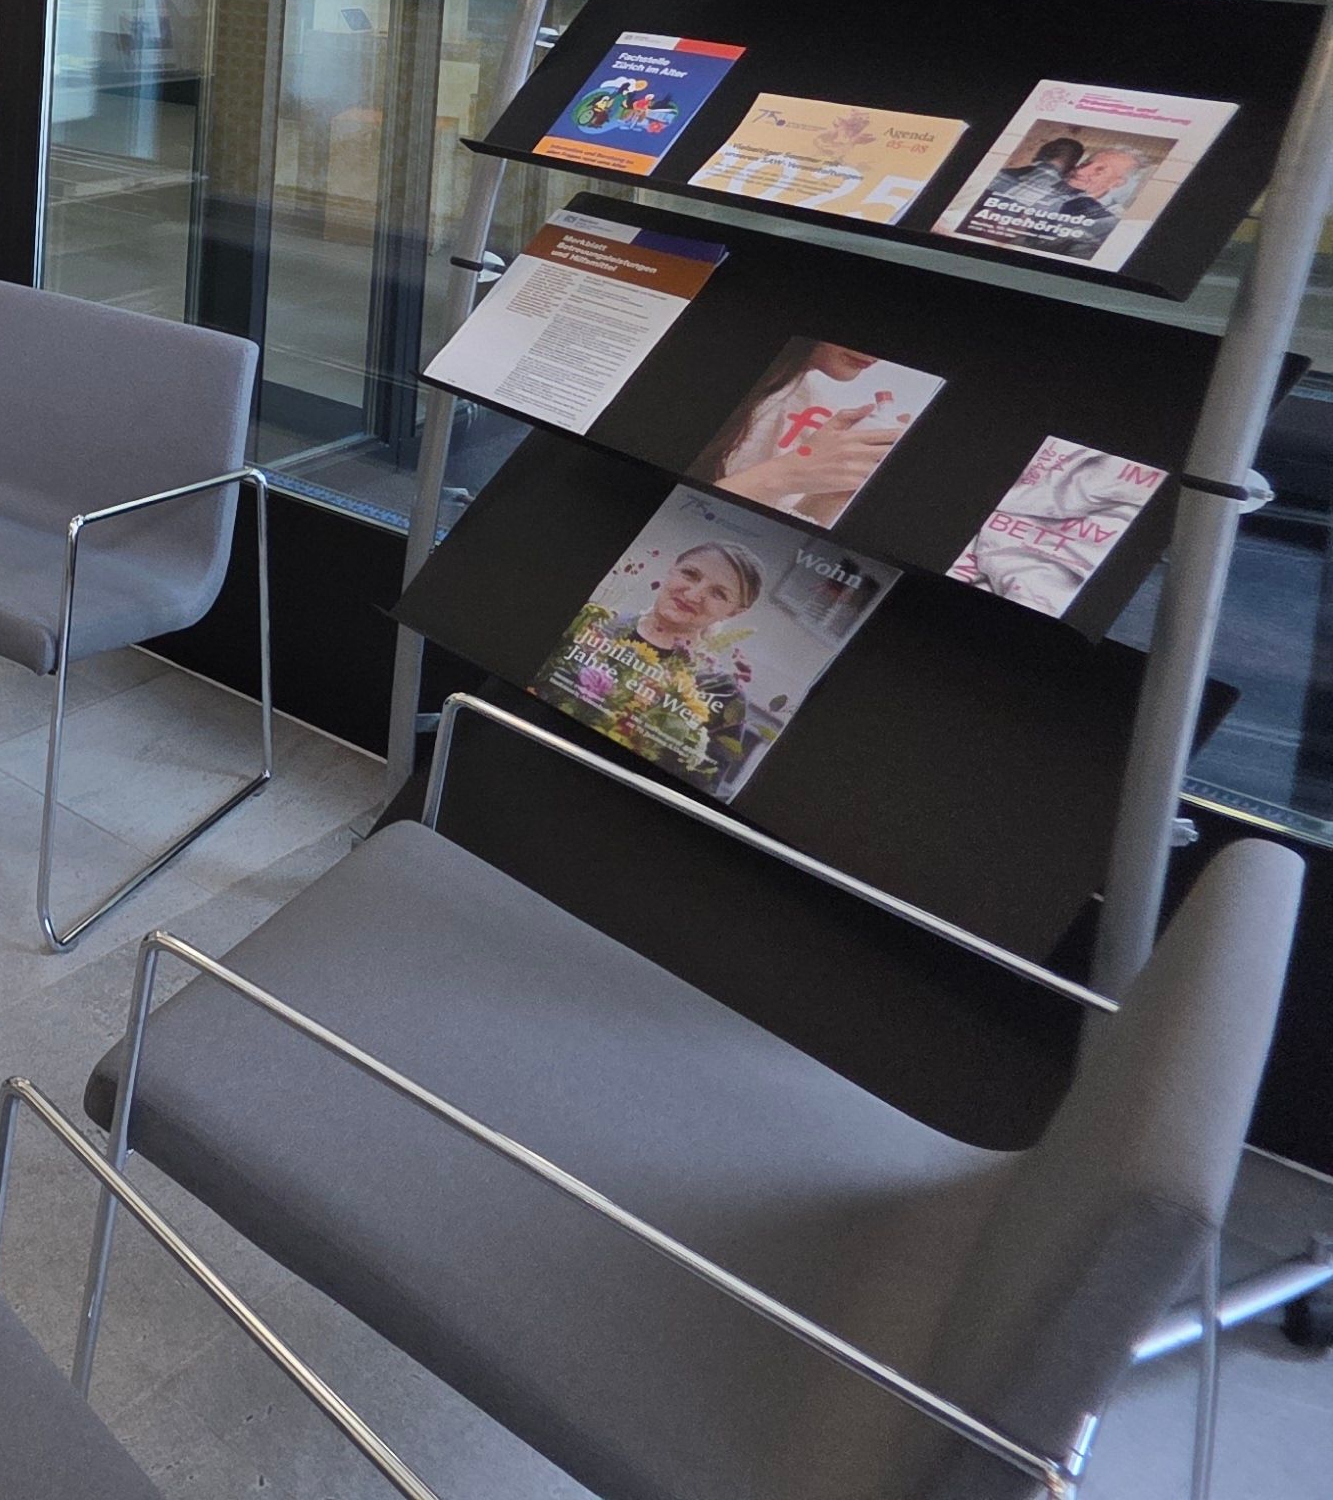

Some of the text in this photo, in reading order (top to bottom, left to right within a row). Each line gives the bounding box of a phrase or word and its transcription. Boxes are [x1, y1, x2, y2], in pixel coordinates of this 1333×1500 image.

[612, 61, 688, 79] Zürich im Alter
[618, 52, 671, 67] Fachstelle
[884, 126, 935, 143] Agenda
[975, 208, 1084, 238] Angehörige
[983, 197, 1095, 227] Betreuende
[563, 234, 608, 252] Merkblatt
[988, 513, 1075, 552] BETT
[795, 548, 863, 590] Wohn
[564, 645, 619, 685] Jahre,
[626, 677, 660, 702] ein
[663, 693, 704, 731] Weg
[676, 682, 724, 714] Viele
